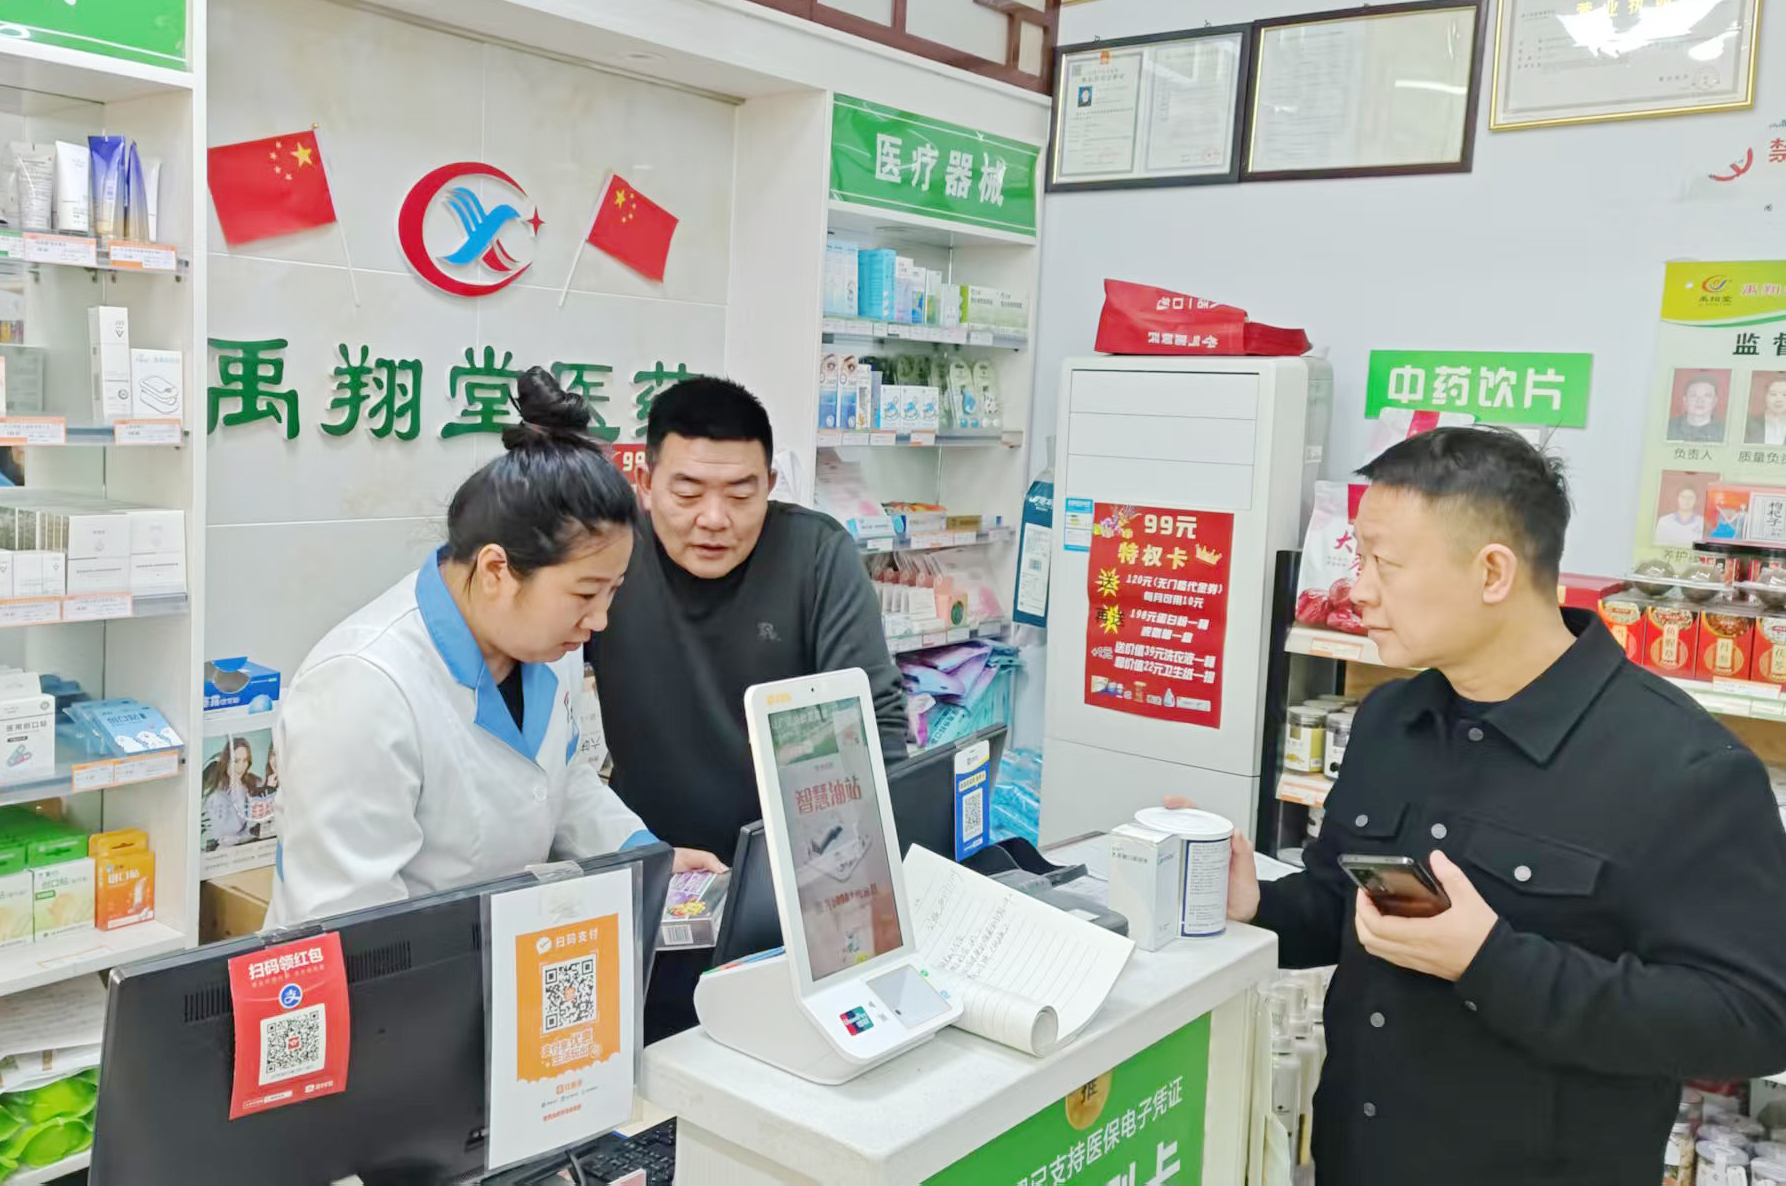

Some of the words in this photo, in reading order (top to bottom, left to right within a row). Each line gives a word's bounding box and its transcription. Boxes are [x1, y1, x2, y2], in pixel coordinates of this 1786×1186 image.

[876, 132, 1007, 208] 医疗器械
[1387, 365, 1565, 411] 中药饮片
[1673, 448, 1713, 460] 负责人
[1144, 513, 1198, 540] 99元
[1117, 541, 1188, 570] 特权卡
[795, 774, 862, 815] 智慧油站
[555, 928, 599, 948] 扫码支付
[248, 947, 324, 981] 扫码领红包
